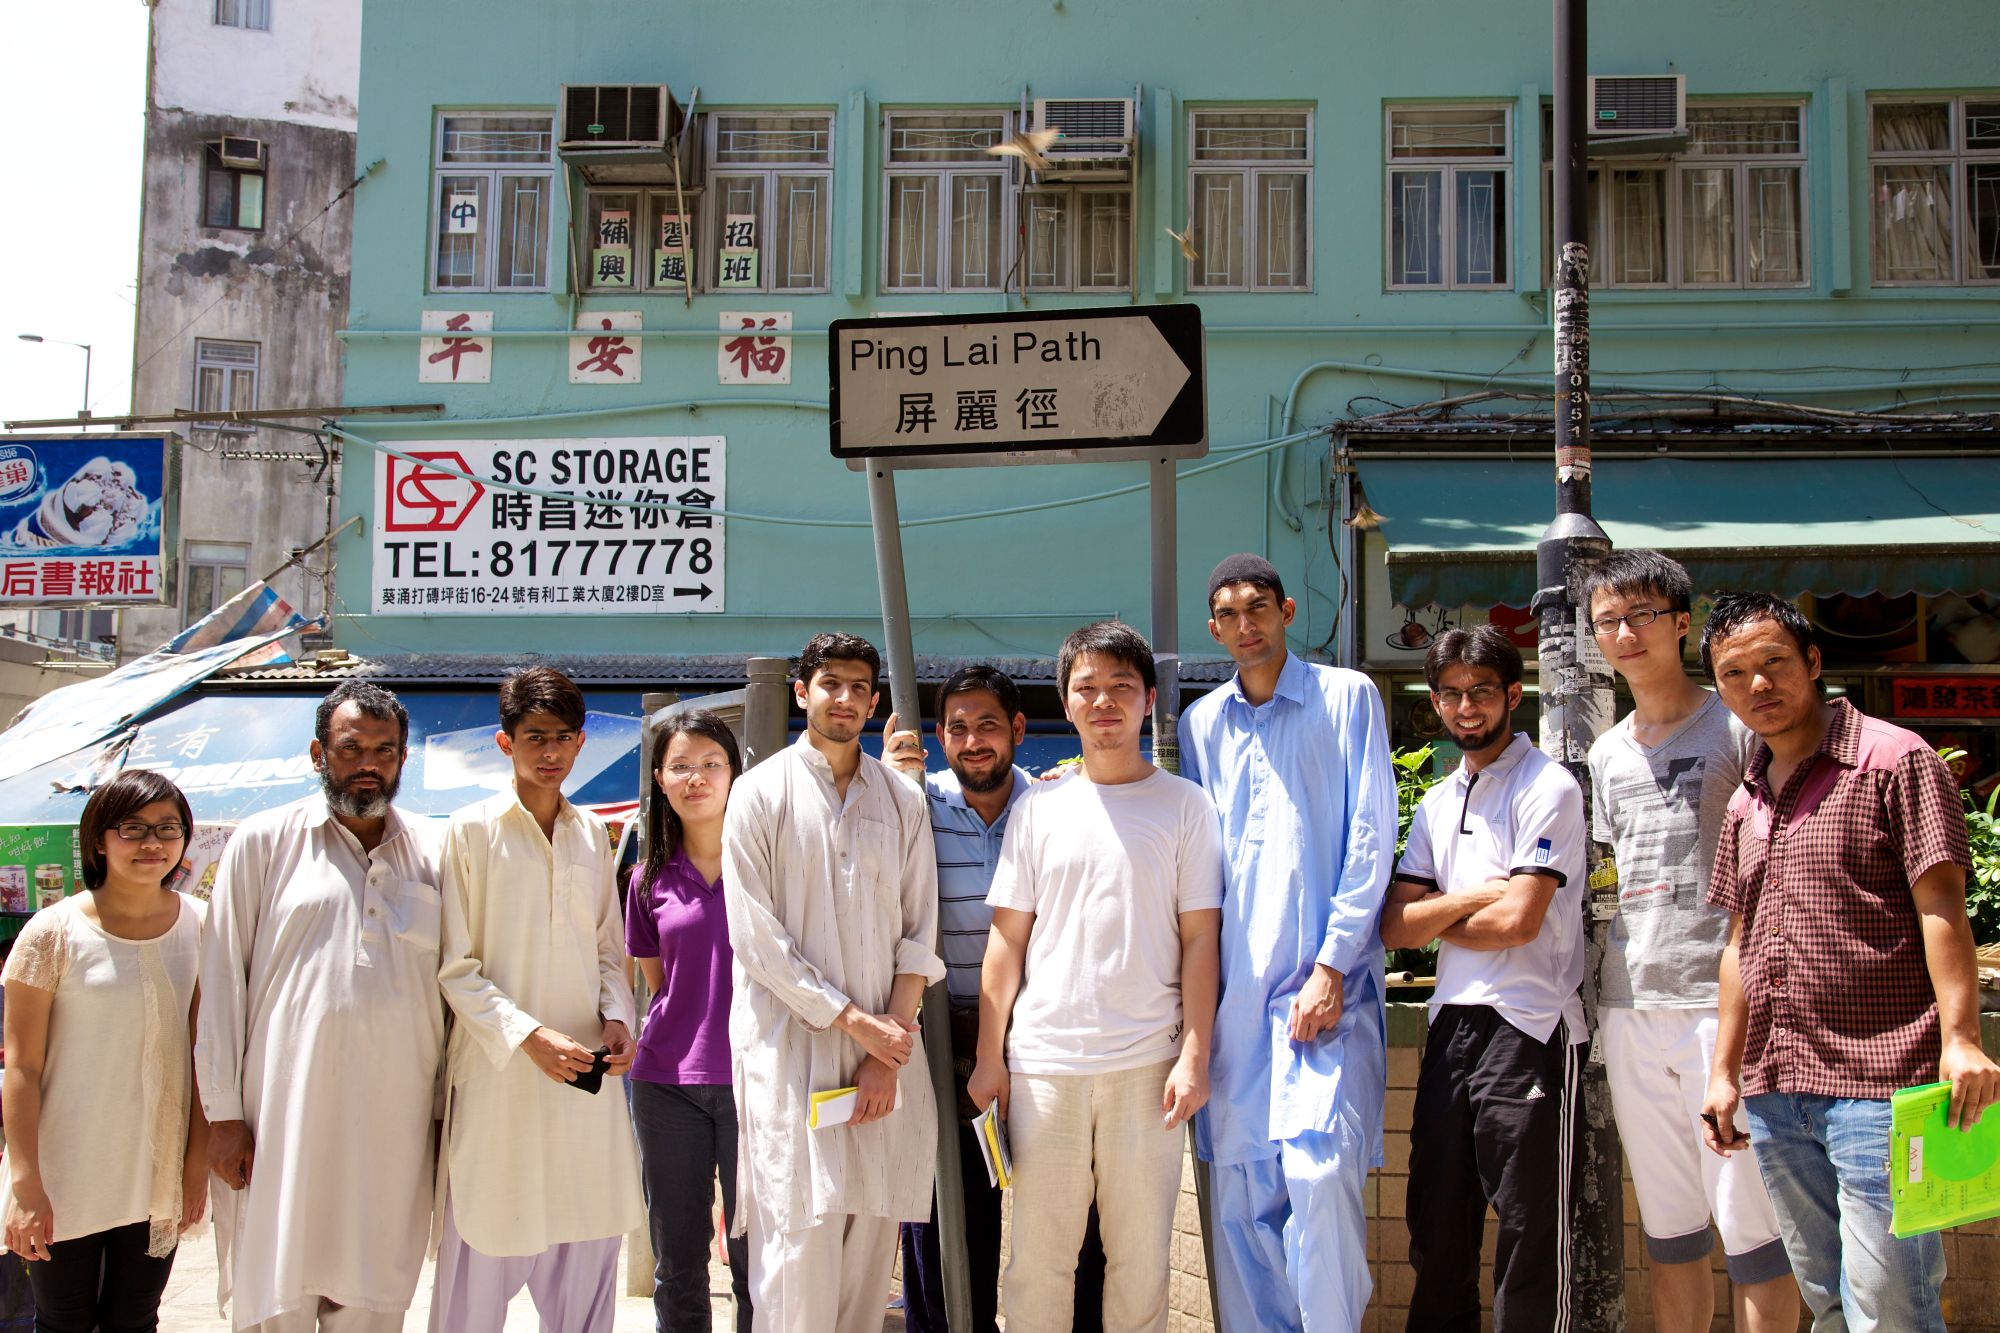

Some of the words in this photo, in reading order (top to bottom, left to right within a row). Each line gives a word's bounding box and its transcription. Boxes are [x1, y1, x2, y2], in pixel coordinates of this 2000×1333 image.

[452, 200, 476, 228] 中
[577, 318, 633, 377] 安
[725, 317, 786, 378] 福
[851, 340, 928, 376] Ping
[943, 335, 998, 367] Lai
[1013, 331, 1101, 364] Path
[895, 388, 1059, 434] 屏麗徑
[491, 450, 537, 486] SC
[551, 448, 711, 485] STORAGE
[491, 488, 716, 531] 時昌迷你倉
[1, 560, 154, 596] 后書報社
